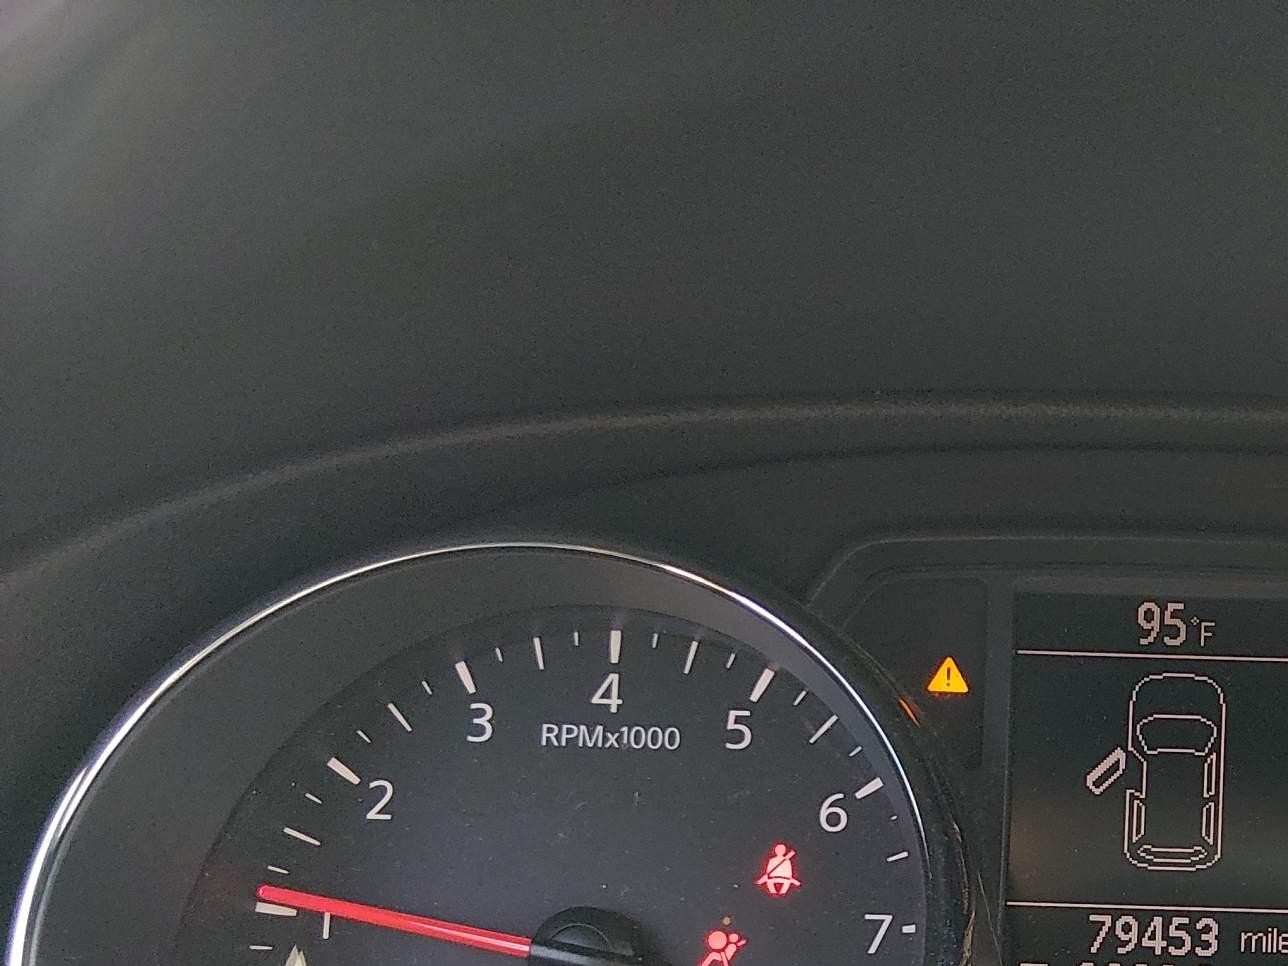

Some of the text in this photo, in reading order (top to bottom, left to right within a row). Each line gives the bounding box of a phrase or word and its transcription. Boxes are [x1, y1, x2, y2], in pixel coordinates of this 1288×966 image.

[1137, 601, 1216, 647] 95°F
[591, 672, 624, 714] 4
[466, 702, 494, 742] 3
[540, 722, 682, 751] RPMx1000
[725, 710, 753, 750] 5
[365, 780, 394, 821] 2
[818, 793, 849, 833] 6
[864, 913, 894, 954] 7
[1089, 914, 1219, 956] 79453
